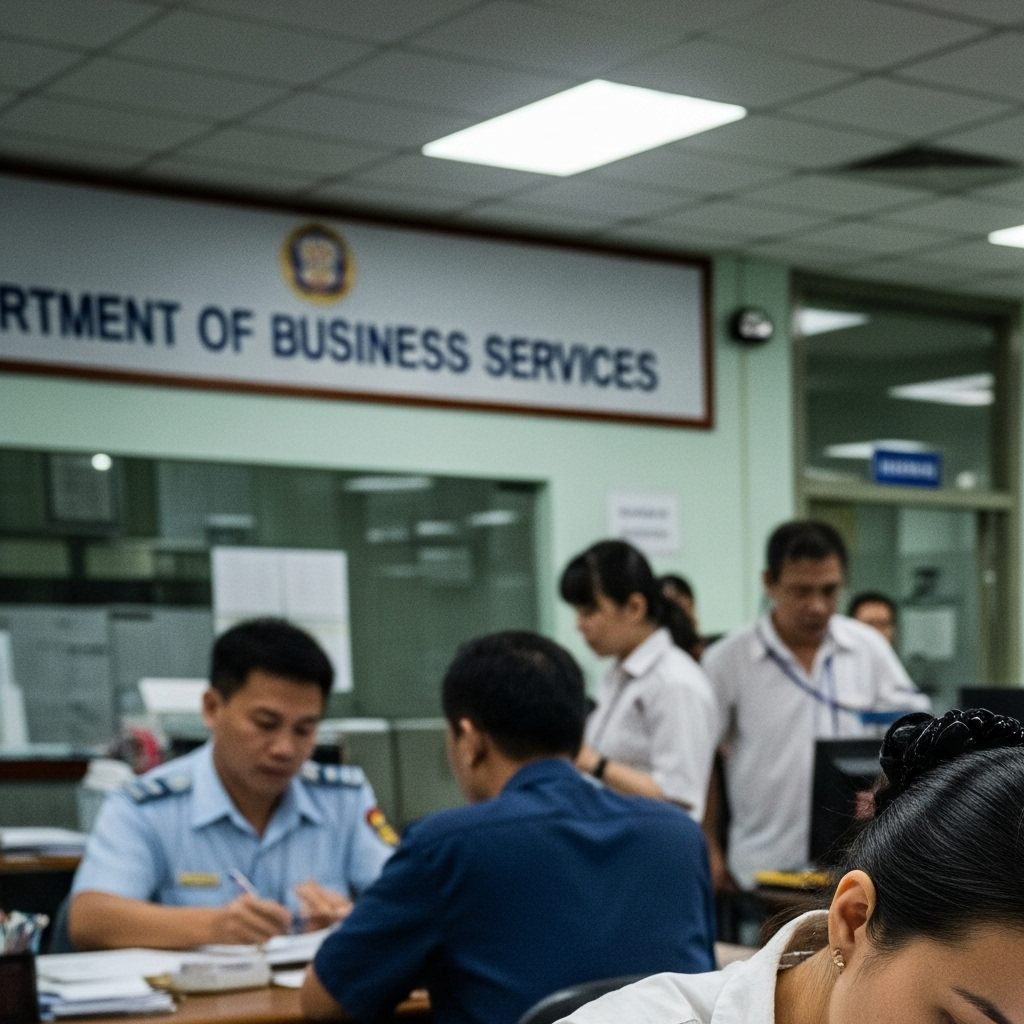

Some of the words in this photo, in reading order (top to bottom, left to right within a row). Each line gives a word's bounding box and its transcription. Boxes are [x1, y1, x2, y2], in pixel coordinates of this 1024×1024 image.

[0, 283, 181, 346] RTMENT
[198, 306, 254, 354] OF
[271, 312, 471, 374] BUSINESS
[484, 334, 659, 392] SERVICES
